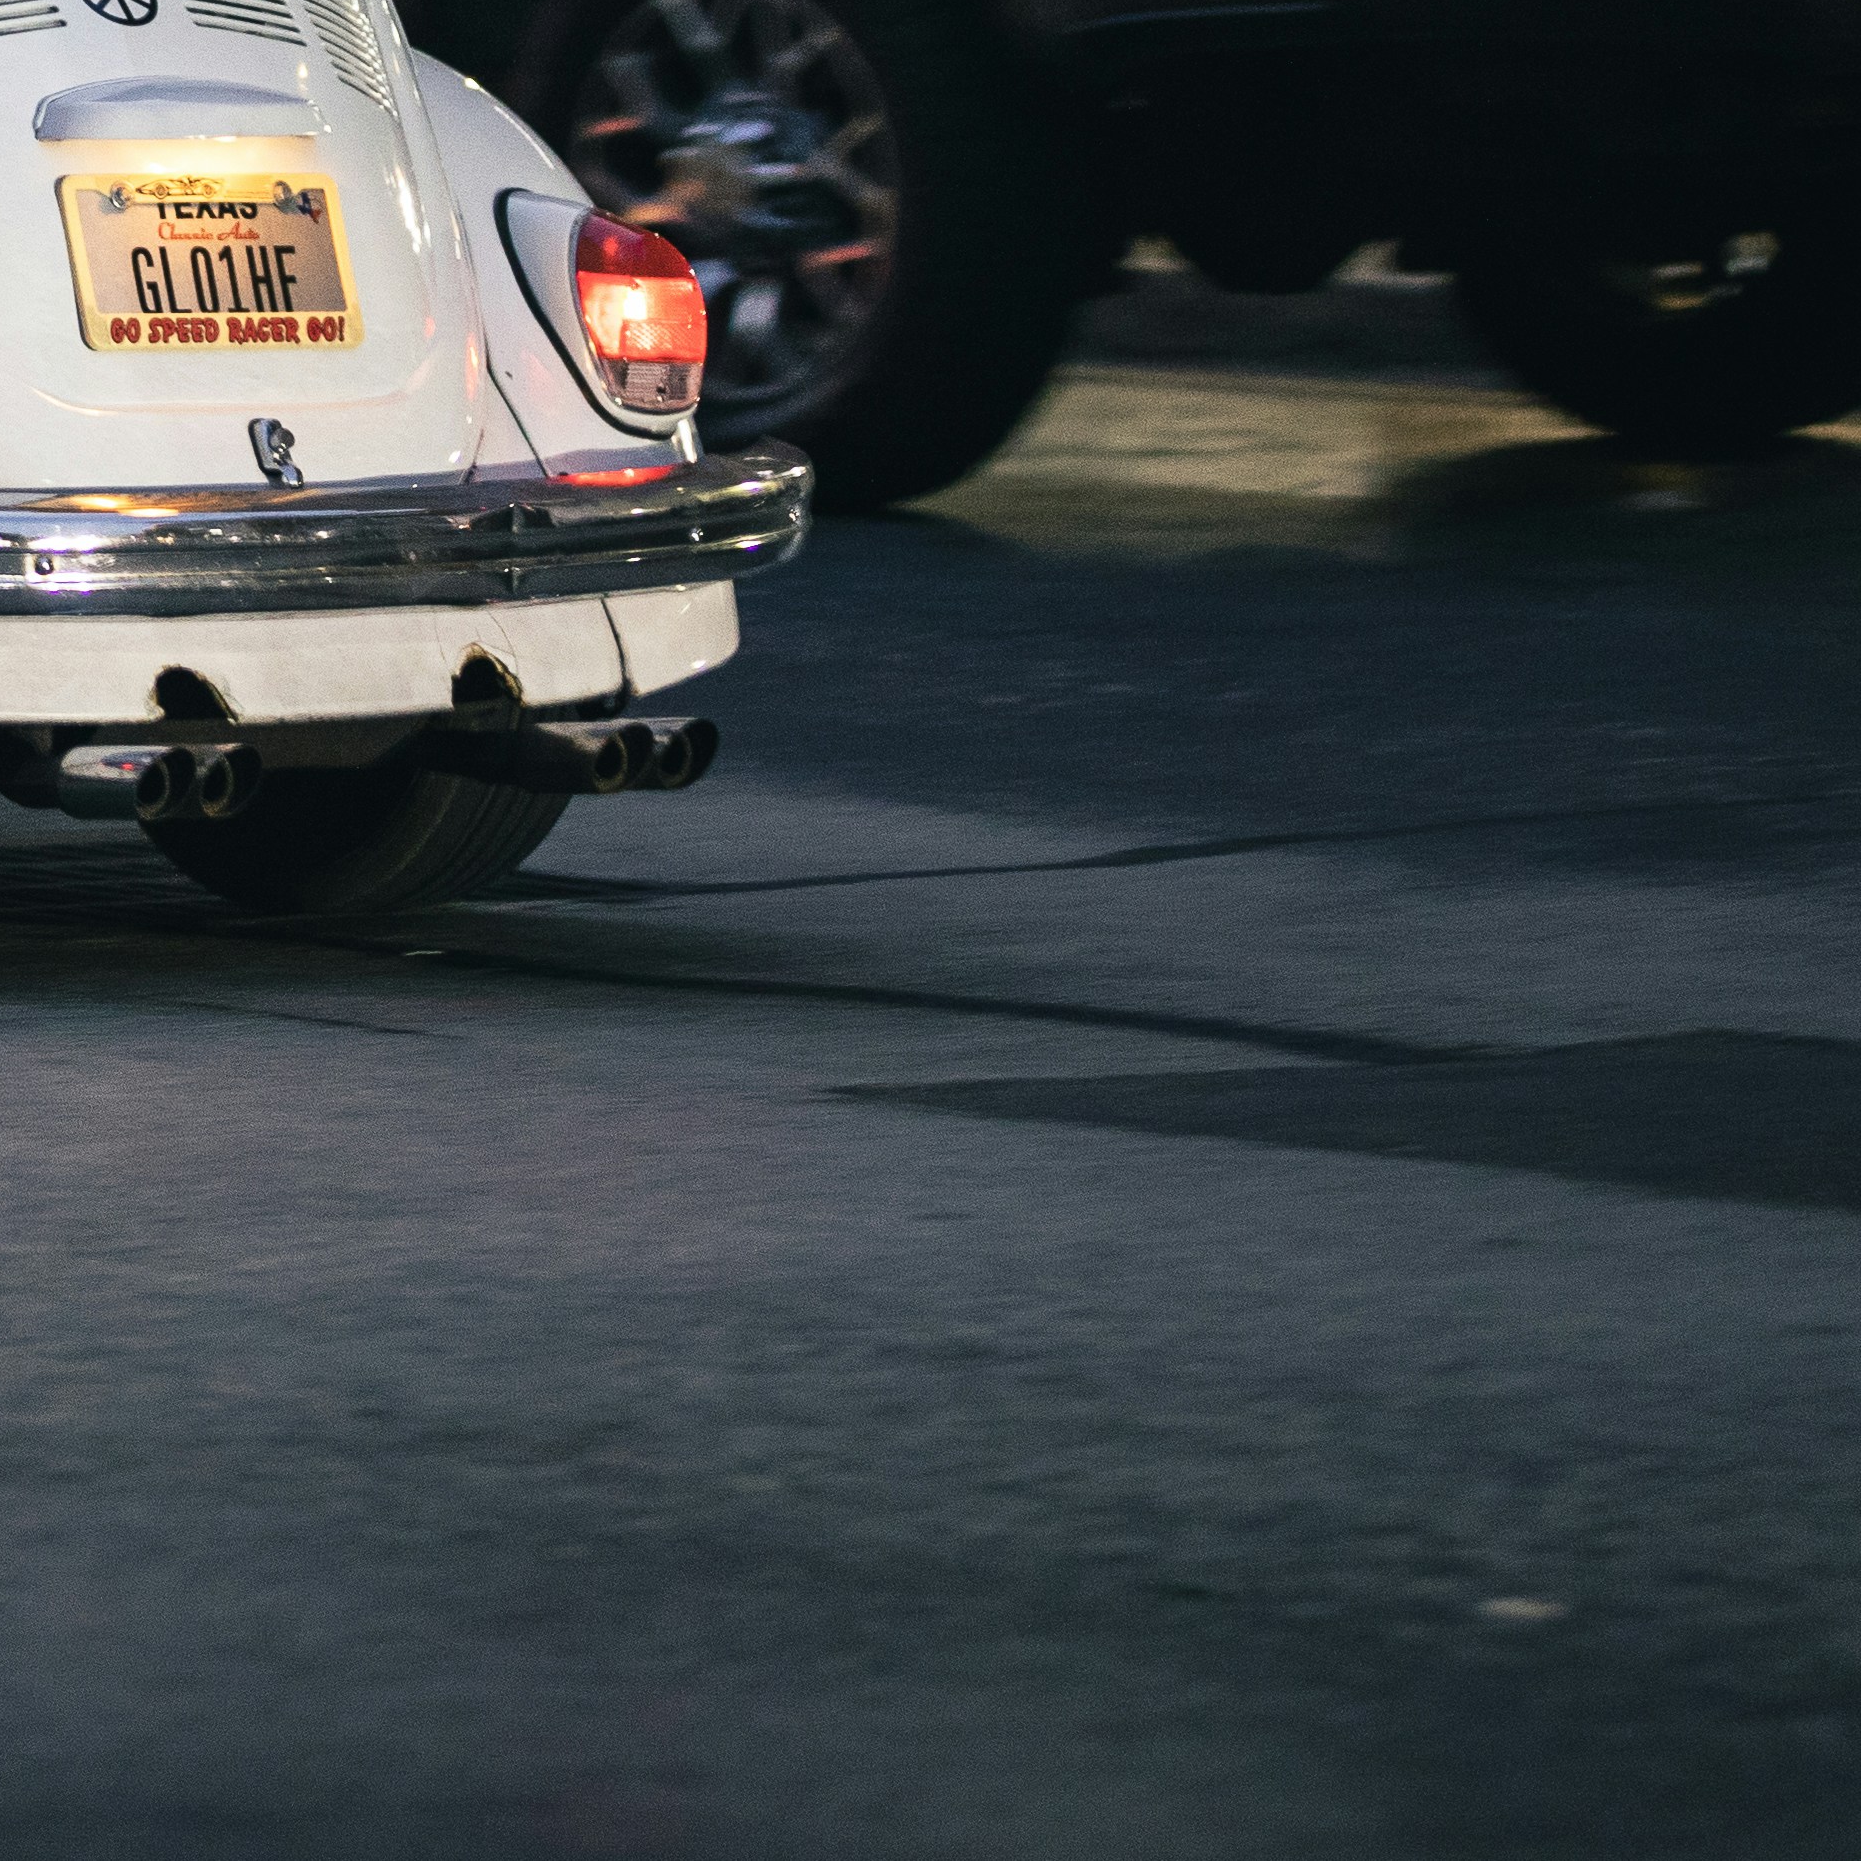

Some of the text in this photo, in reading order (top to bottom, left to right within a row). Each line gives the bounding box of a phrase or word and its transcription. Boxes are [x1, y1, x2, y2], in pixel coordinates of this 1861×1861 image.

[157, 202, 258, 219] TEXAS
[110, 316, 346, 345] GO SPEED RACER GO!
